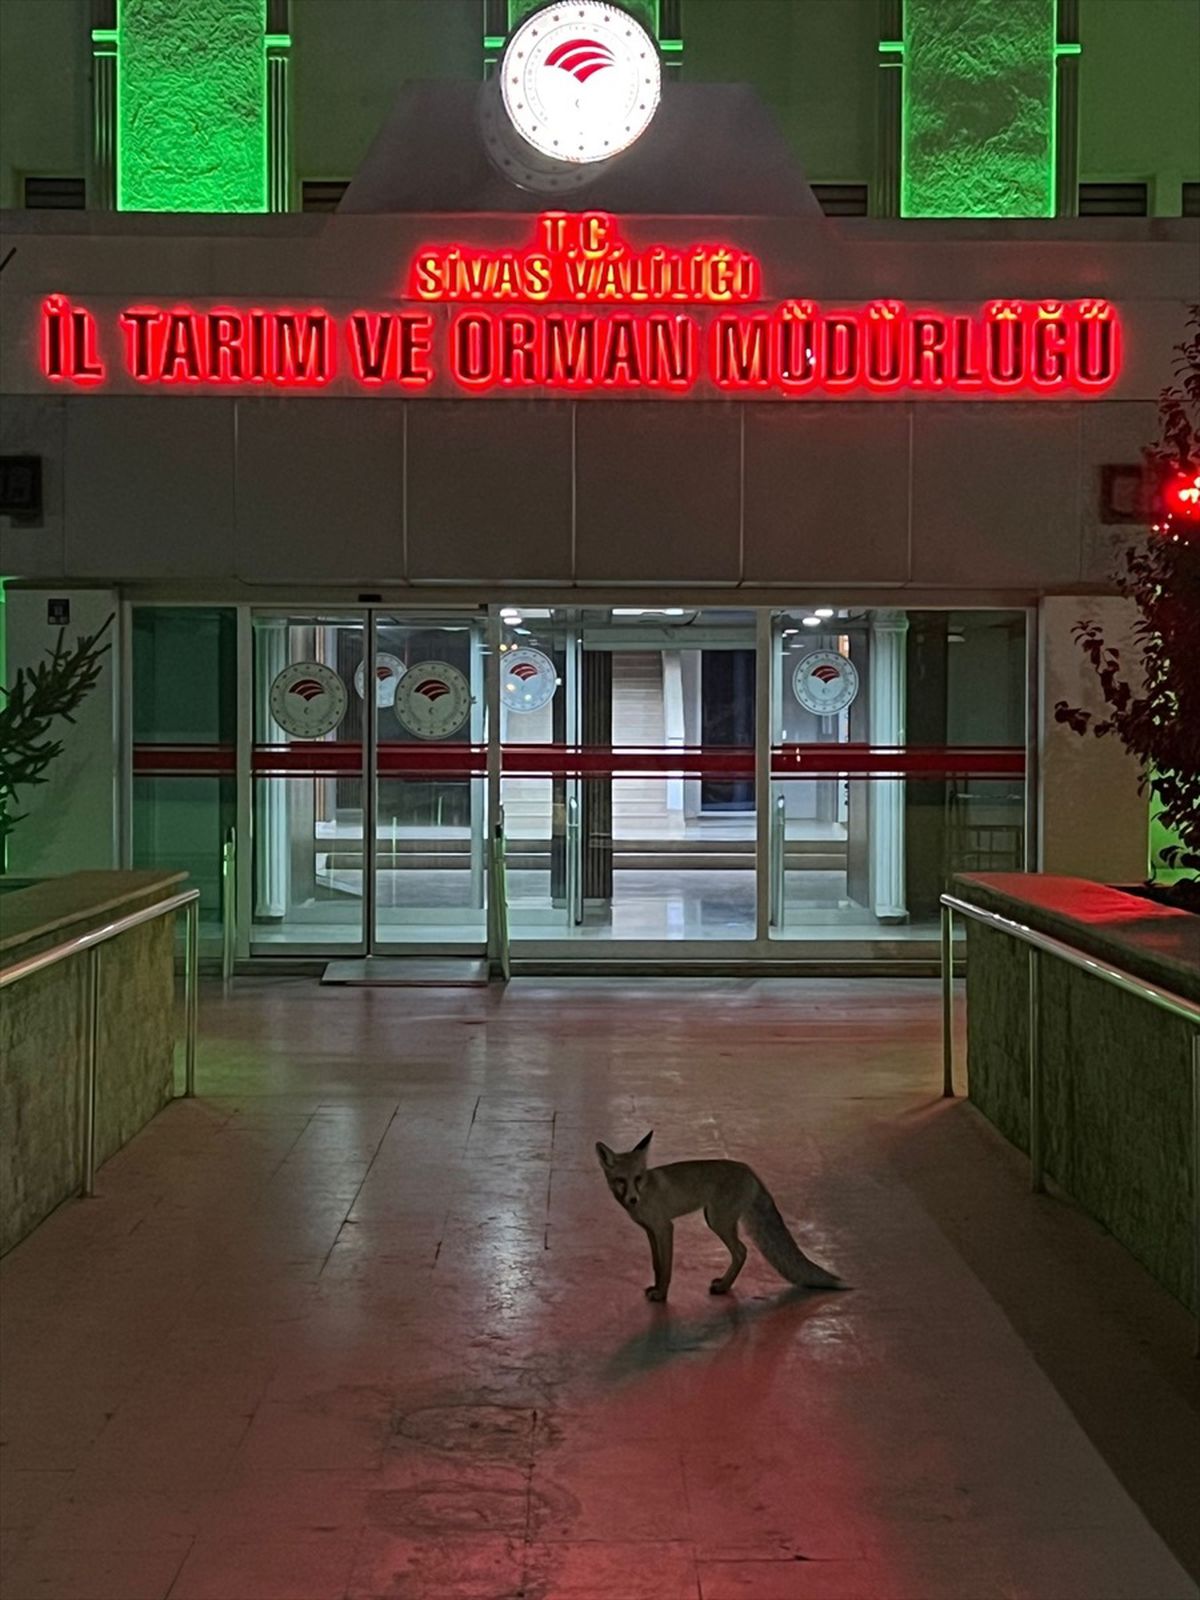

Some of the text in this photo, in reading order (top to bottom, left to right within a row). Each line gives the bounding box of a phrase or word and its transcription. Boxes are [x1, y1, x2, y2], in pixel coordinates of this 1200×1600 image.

[541, 211, 624, 259] T.C.
[416, 247, 552, 300] SİVAS
[45, 294, 1116, 385] İL TARIM VE ORMAN MÜDÜRLÜĞÜ
